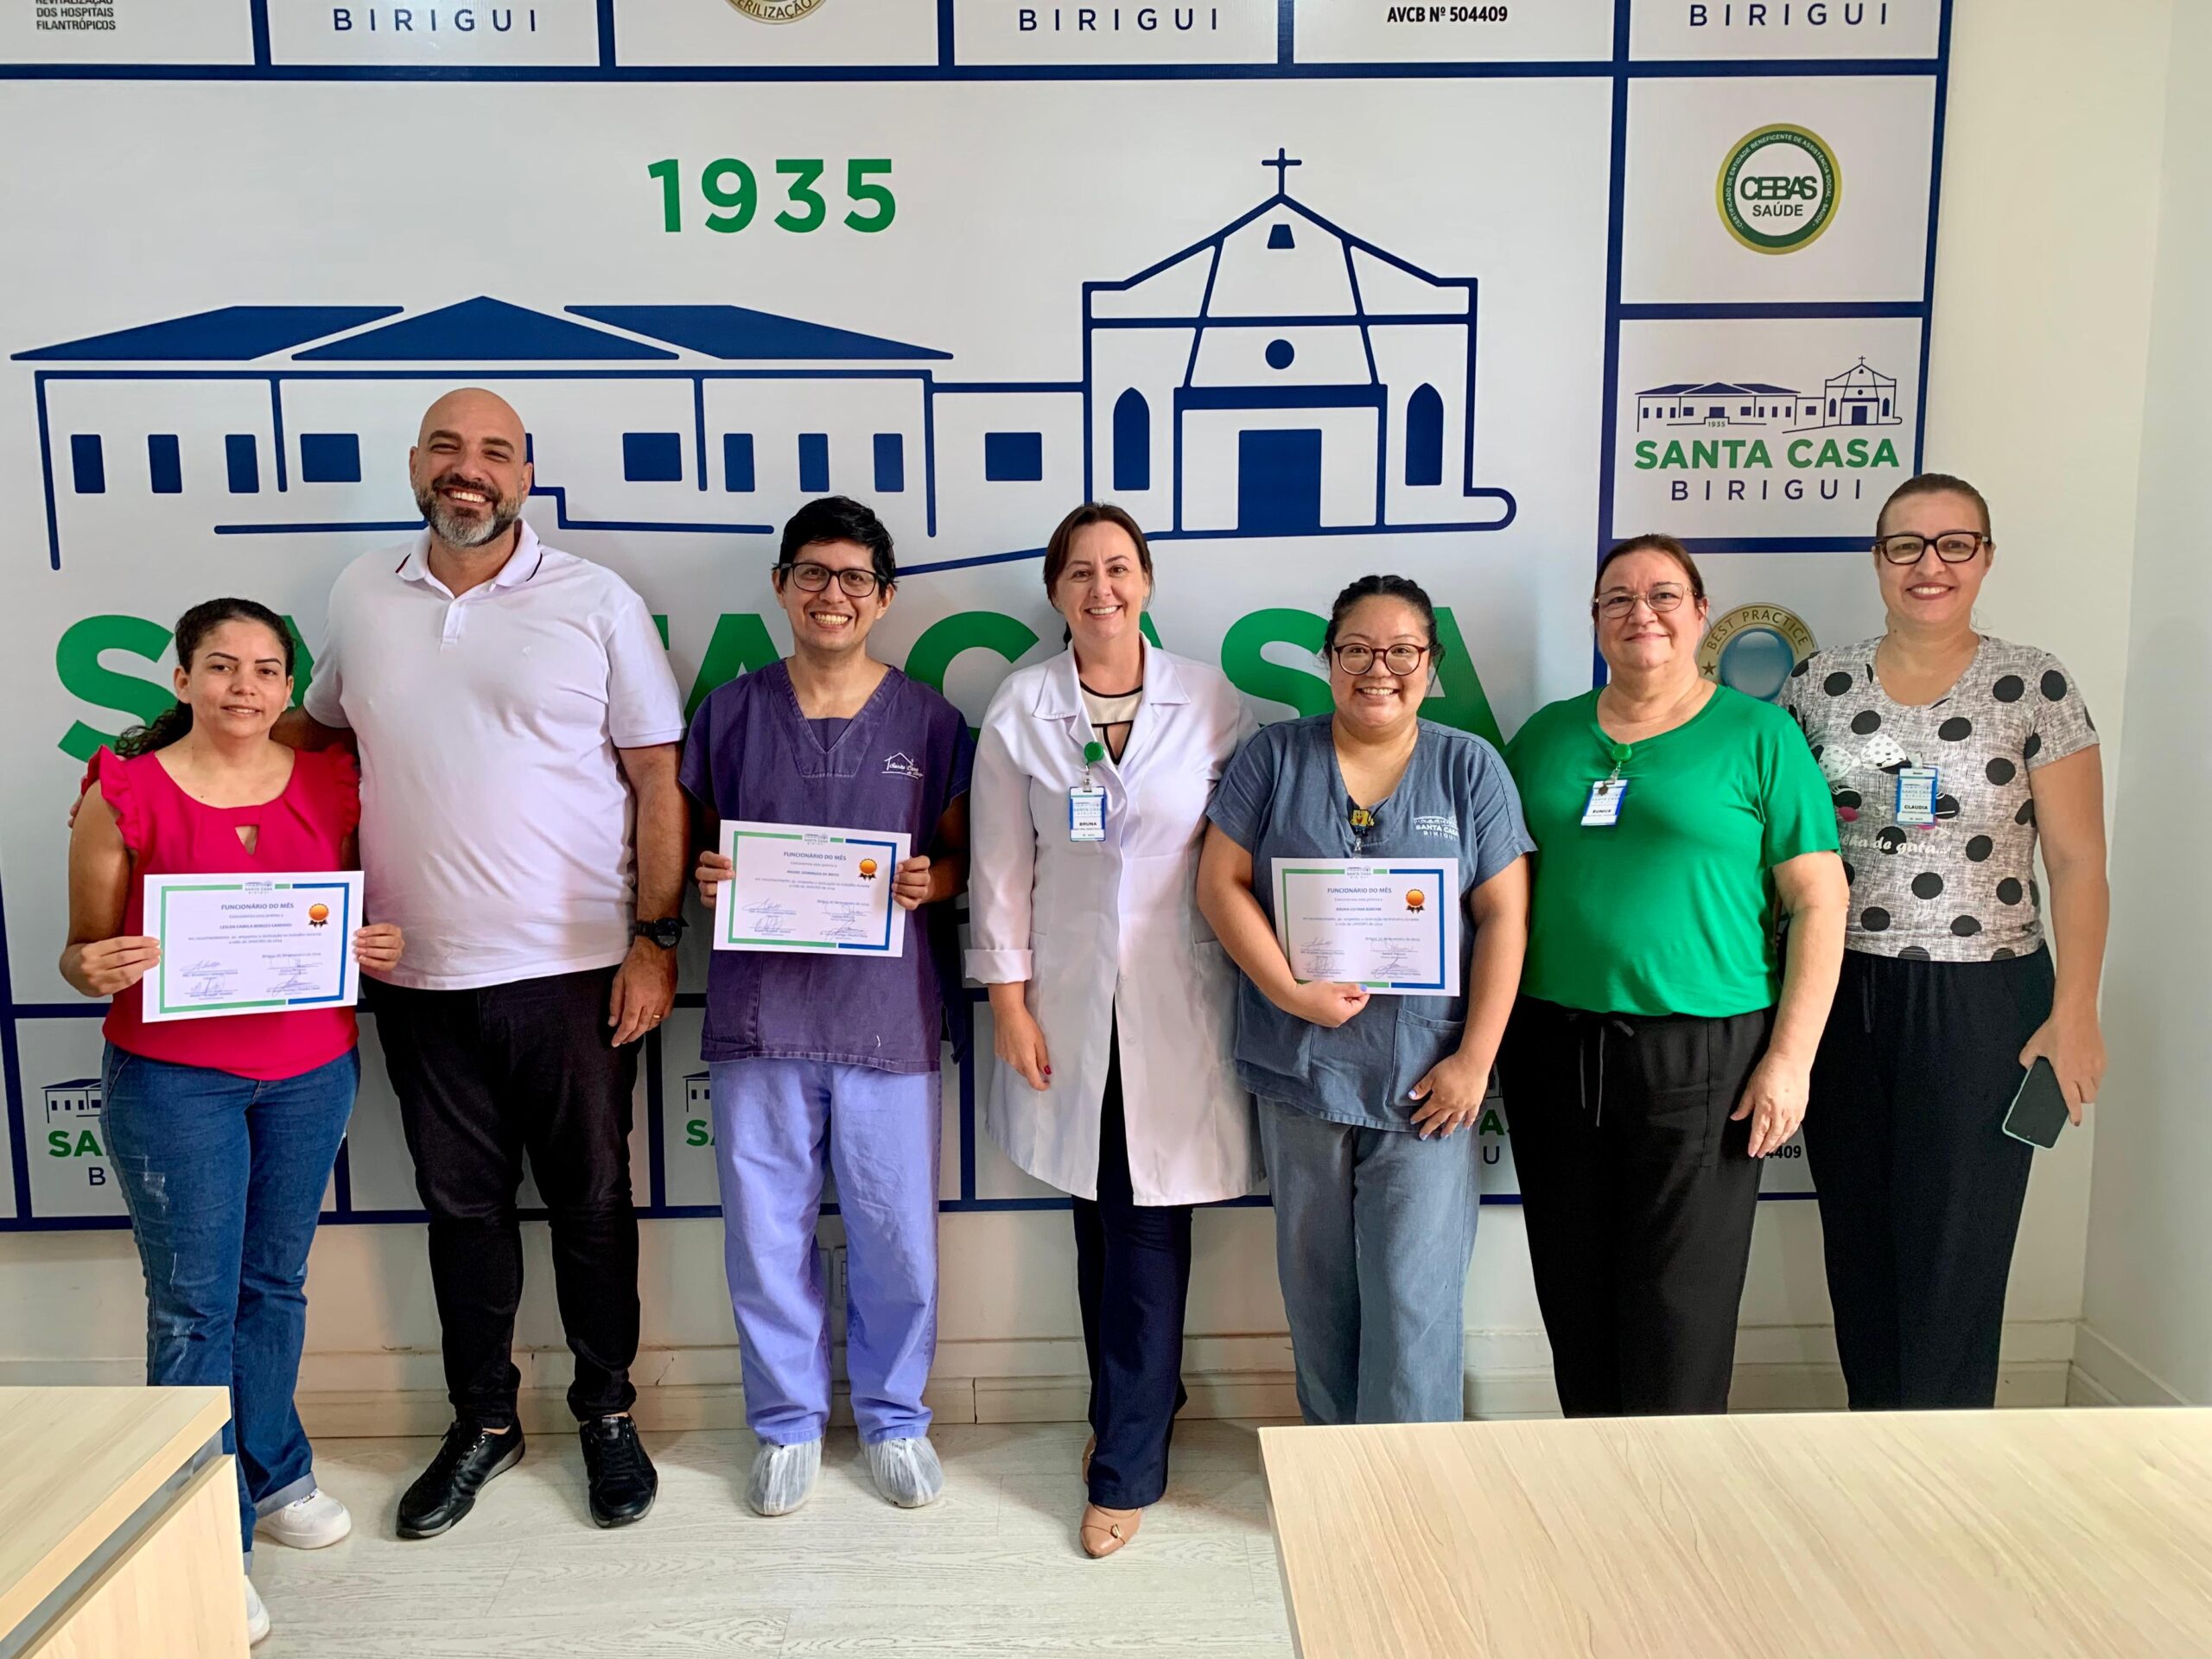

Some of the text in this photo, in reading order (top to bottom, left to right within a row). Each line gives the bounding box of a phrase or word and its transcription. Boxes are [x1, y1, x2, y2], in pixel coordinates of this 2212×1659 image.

[36, 7, 114, 17] DOS HOSPITAIS
[334, 9, 536, 31] BIRIGUI
[1020, 9, 1217, 31] BIRIGUI
[1387, 6, 1508, 22] AVCB Nº 504409
[1689, 3, 1886, 26] BIRIGUI
[36, 17, 116, 30] FILANTRÓPICOS
[1750, 134, 1793, 149] BENEFICENTE
[647, 158, 896, 233] 1935
[1740, 176, 1818, 200] CEBAS
[1752, 201, 1804, 217] SAÚDE
[1634, 438, 1900, 469] SANTA CASA
[1671, 479, 1860, 501] BIRIGUI
[1707, 609, 1808, 651] BEST PRACTICE
[904, 607, 1507, 753] CSA
